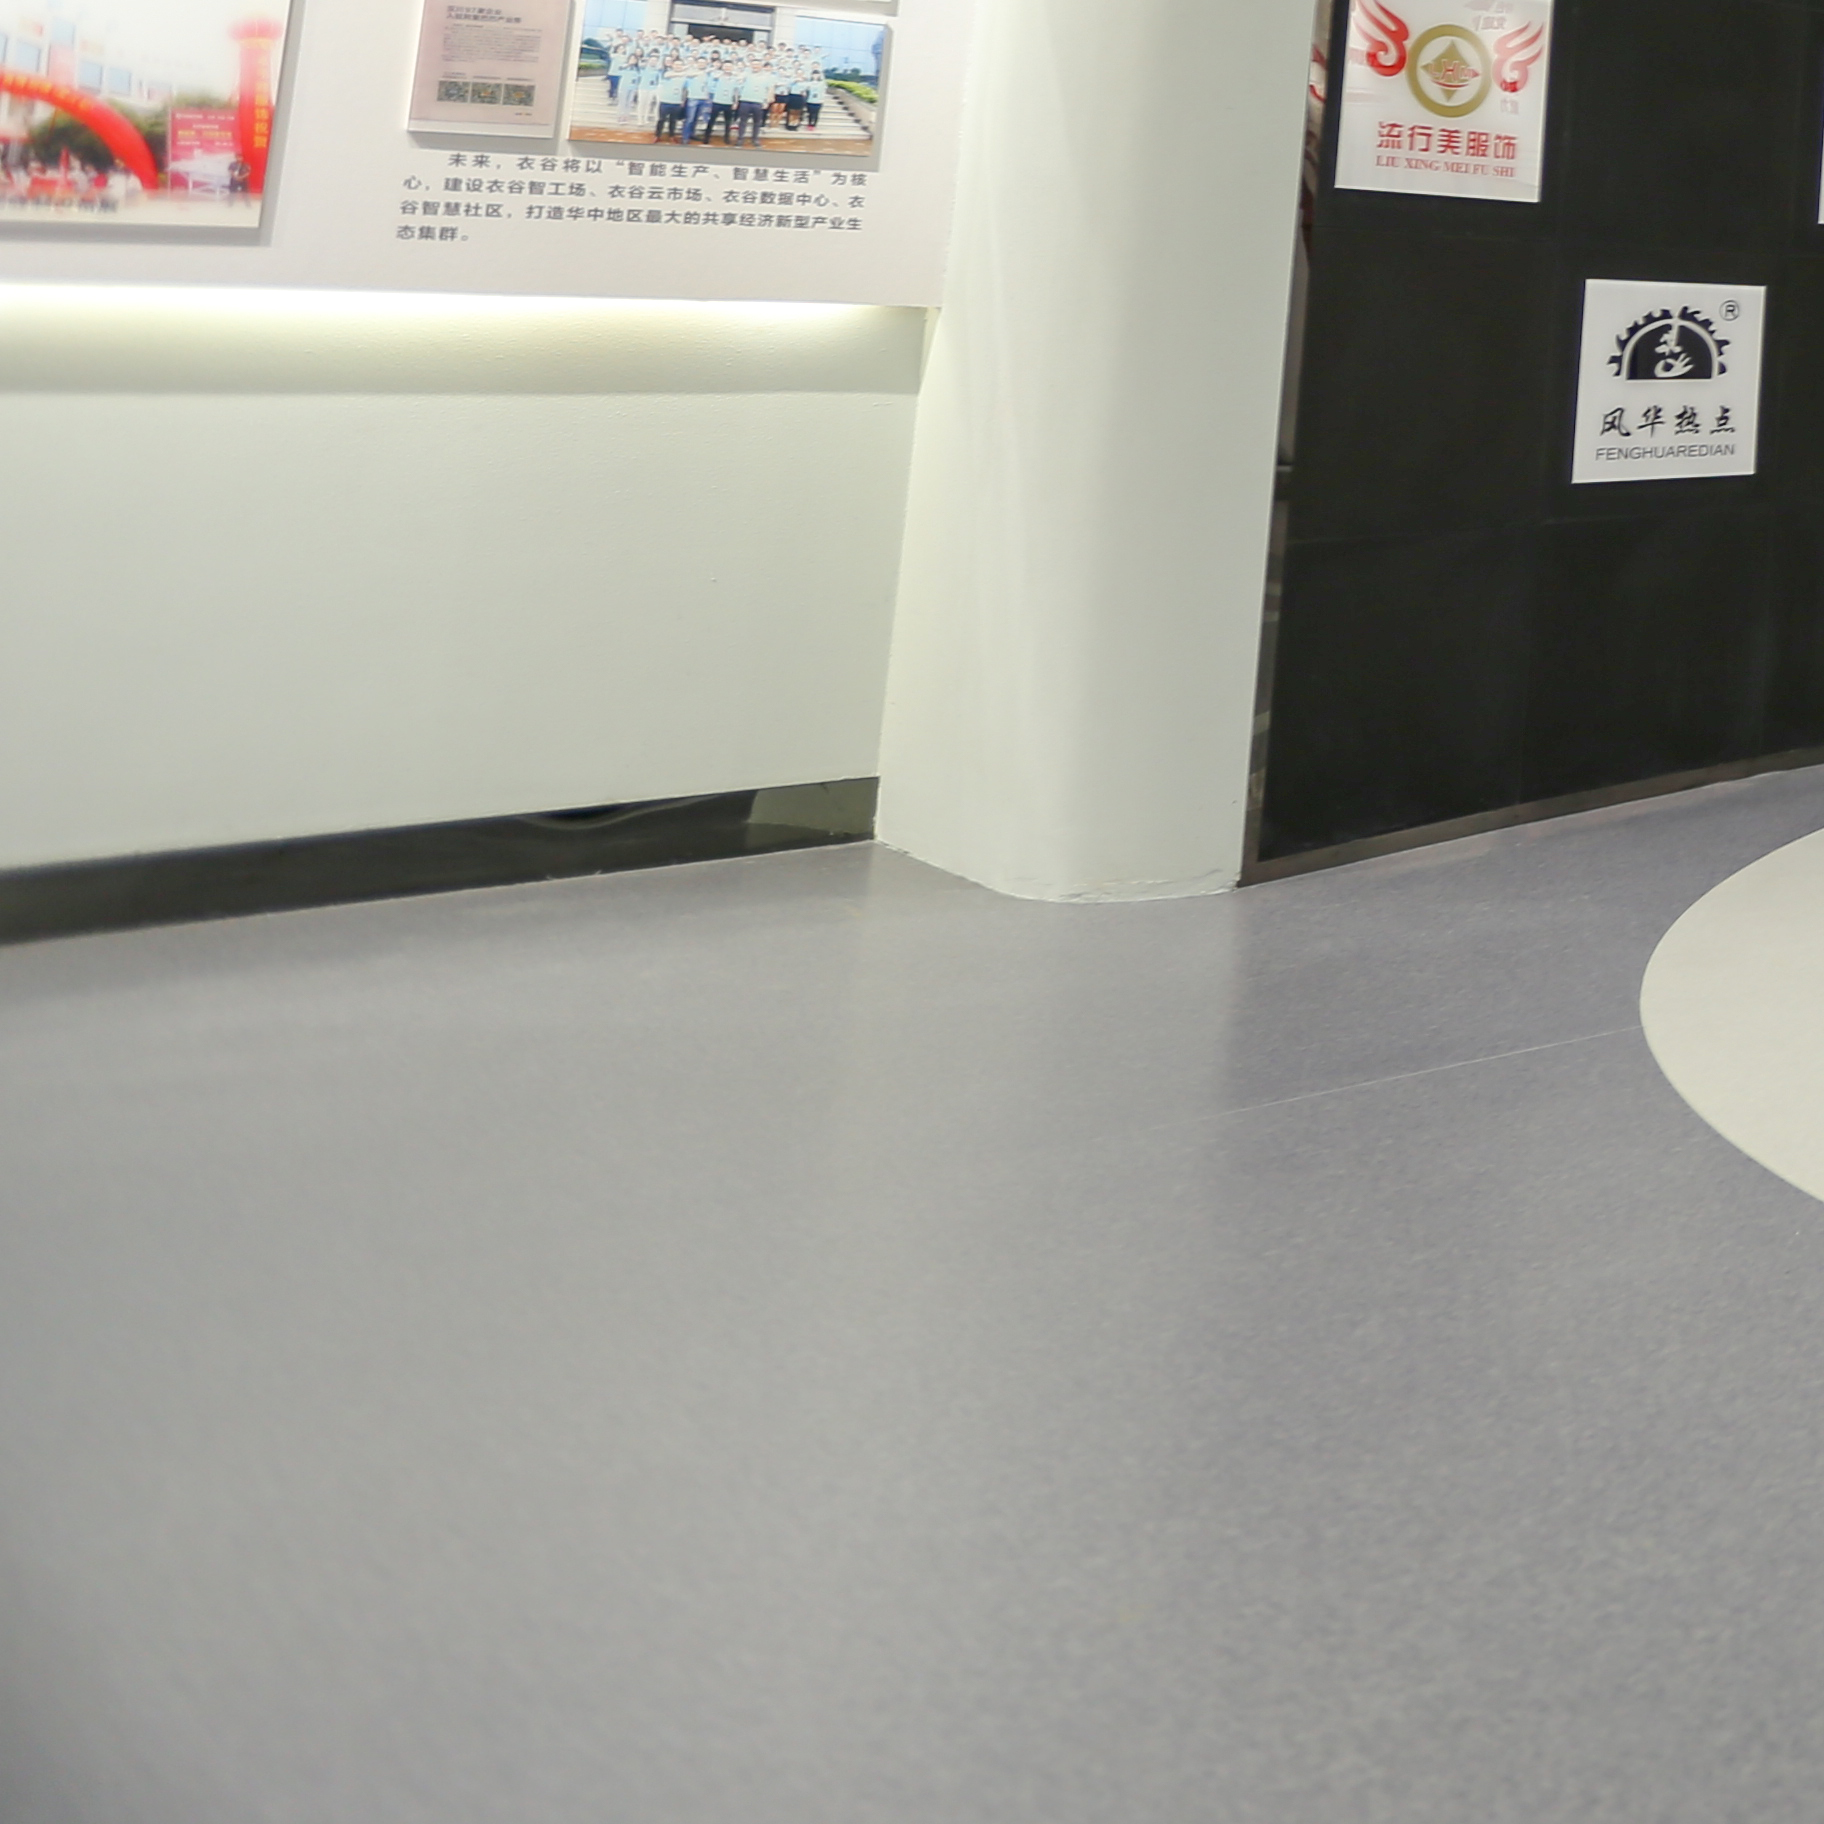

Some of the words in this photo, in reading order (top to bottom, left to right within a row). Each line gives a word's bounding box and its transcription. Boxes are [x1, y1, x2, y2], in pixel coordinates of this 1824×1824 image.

[1376, 121, 1517, 160] 流行美服饰
[1376, 154, 1400, 168] LIU
[1404, 156, 1440, 172] XING
[1443, 159, 1472, 174] MEI
[1473, 161, 1490, 175] FU
[1492, 163, 1516, 177] SHI
[1599, 405, 1736, 437] 风华热点
[1595, 444, 1735, 461] FENGHUAREDIAN
